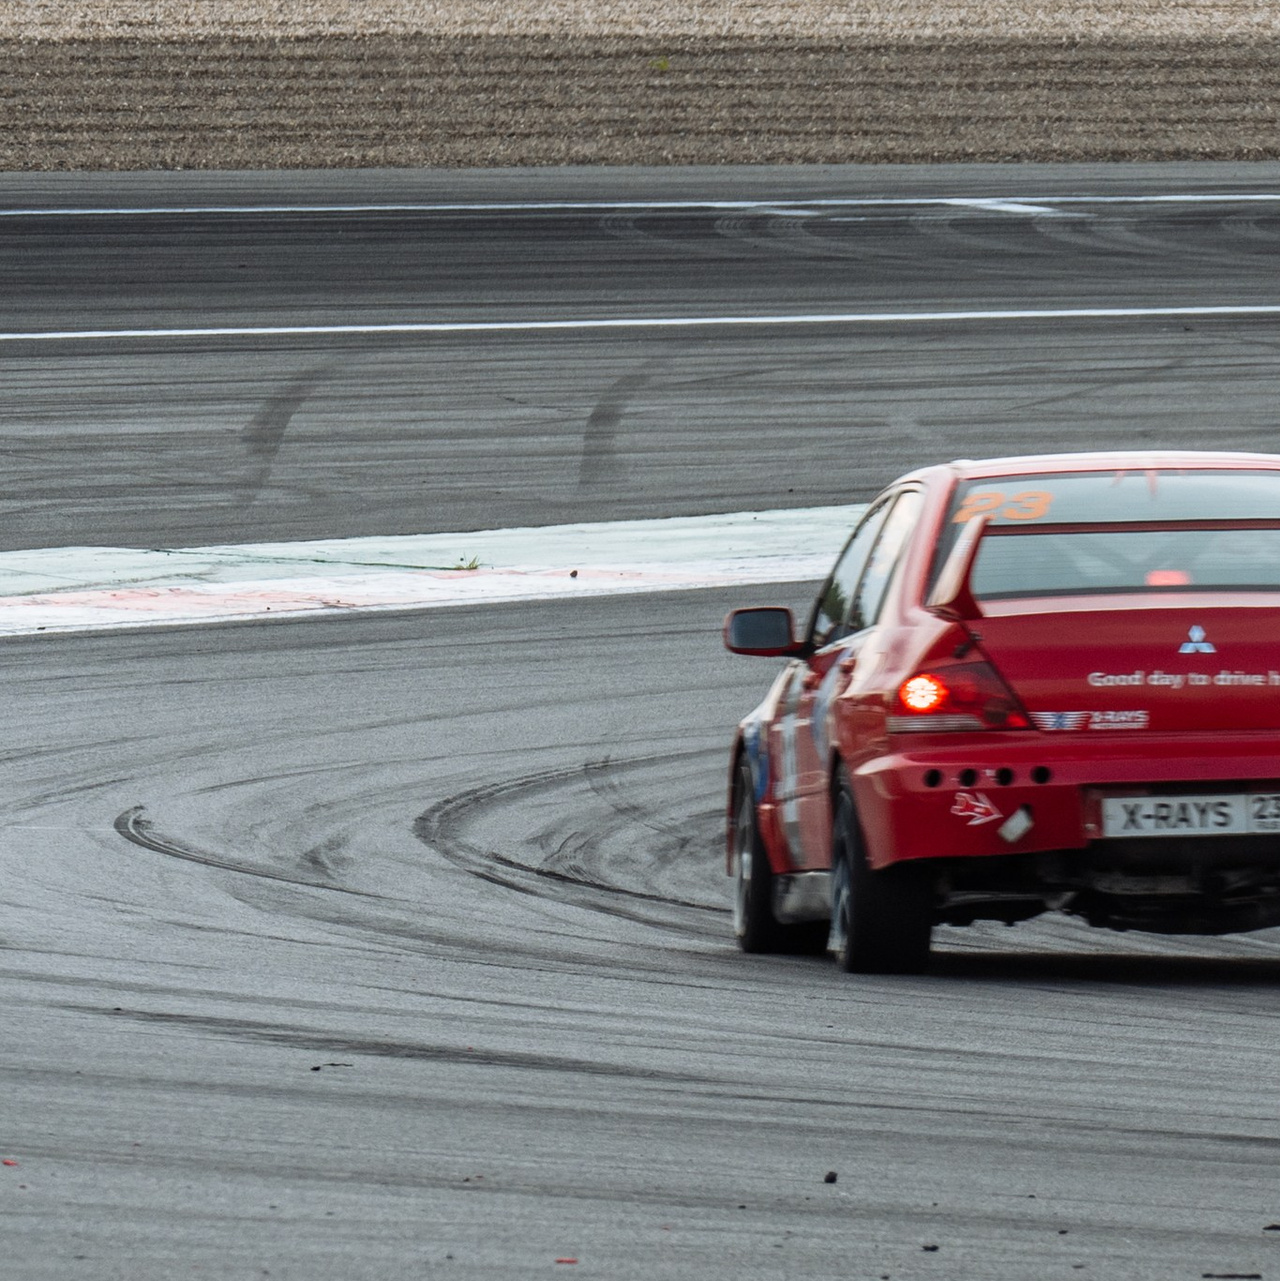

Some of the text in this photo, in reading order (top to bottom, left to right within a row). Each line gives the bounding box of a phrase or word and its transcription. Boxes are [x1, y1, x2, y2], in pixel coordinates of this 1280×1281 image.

[951, 491, 1054, 523] 23
[1087, 670, 1144, 687] Good
[1147, 670, 1184, 689] day
[1187, 671, 1210, 686] to
[1213, 670, 1265, 686] drive
[1120, 801, 1234, 829] X-RAYS
